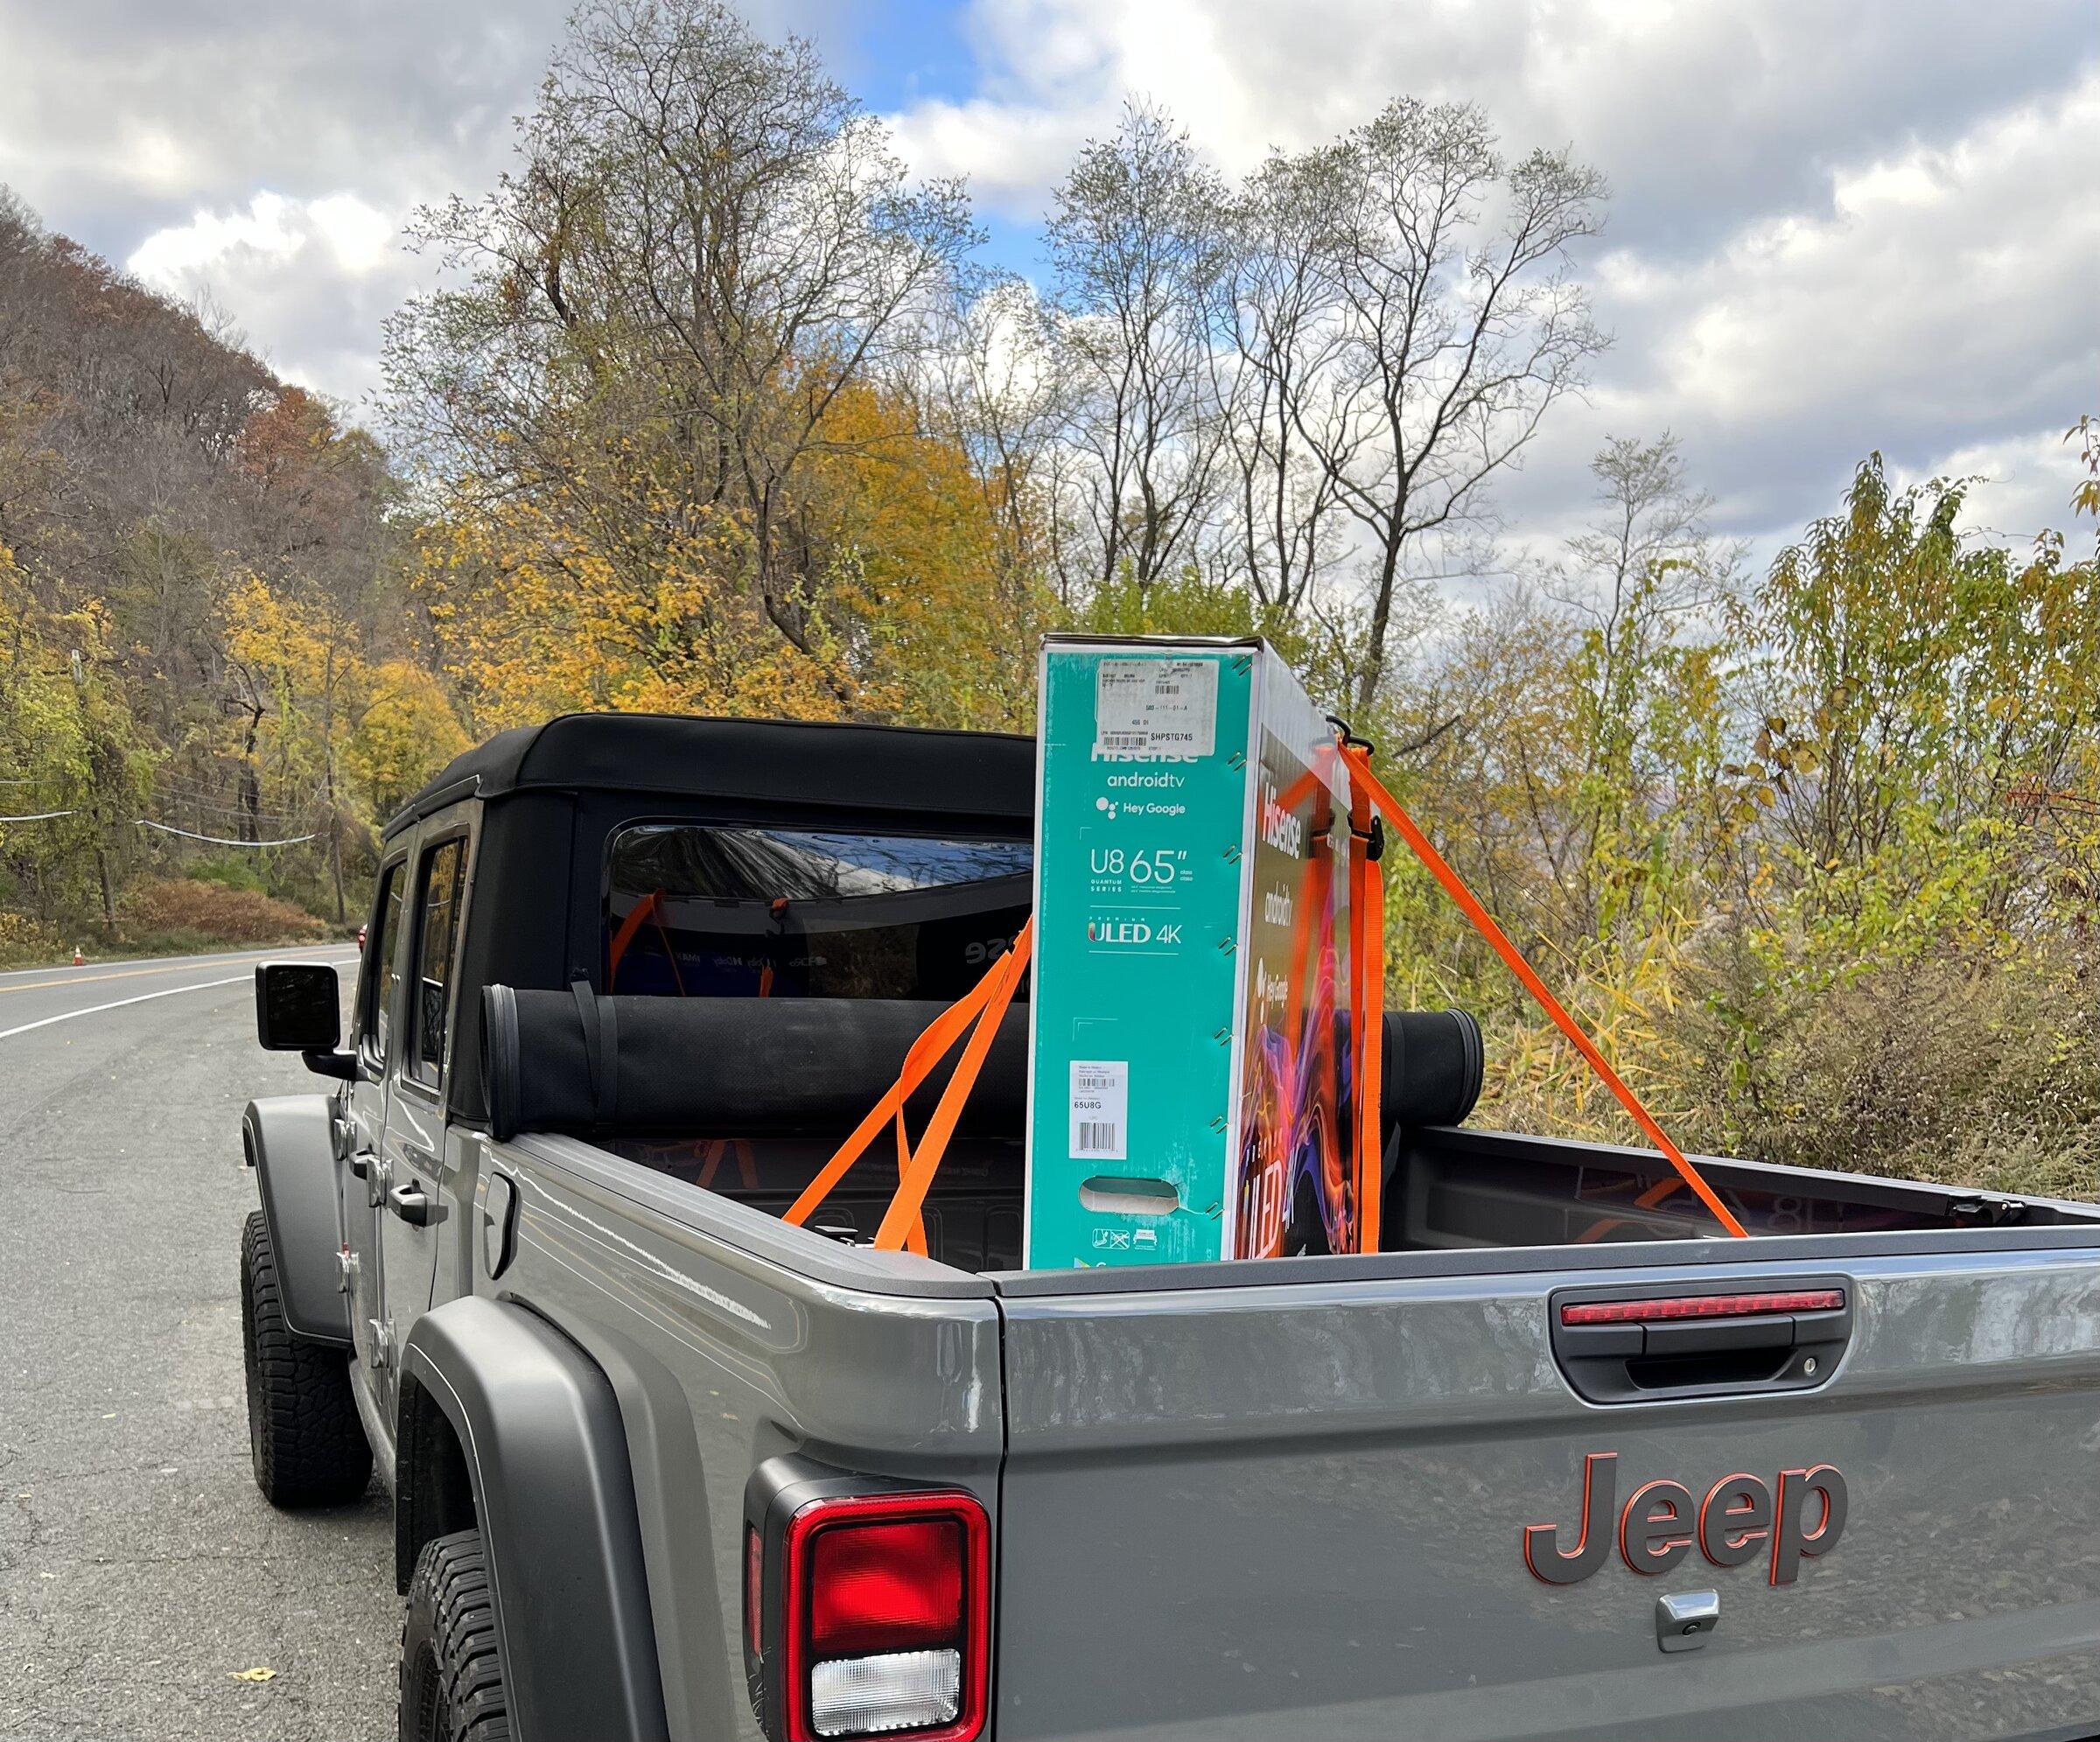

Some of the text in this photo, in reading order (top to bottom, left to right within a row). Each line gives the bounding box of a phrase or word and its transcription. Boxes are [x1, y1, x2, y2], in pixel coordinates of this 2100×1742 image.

[1151, 732, 1193, 741] SHPSTG745
[1124, 802, 1186, 815] Hey Google
[1262, 781, 1301, 859] Hisense
[1091, 848, 1124, 874] U8
[1088, 921, 1183, 944] ULED 4K
[1523, 1451, 1848, 1586] Jeep
